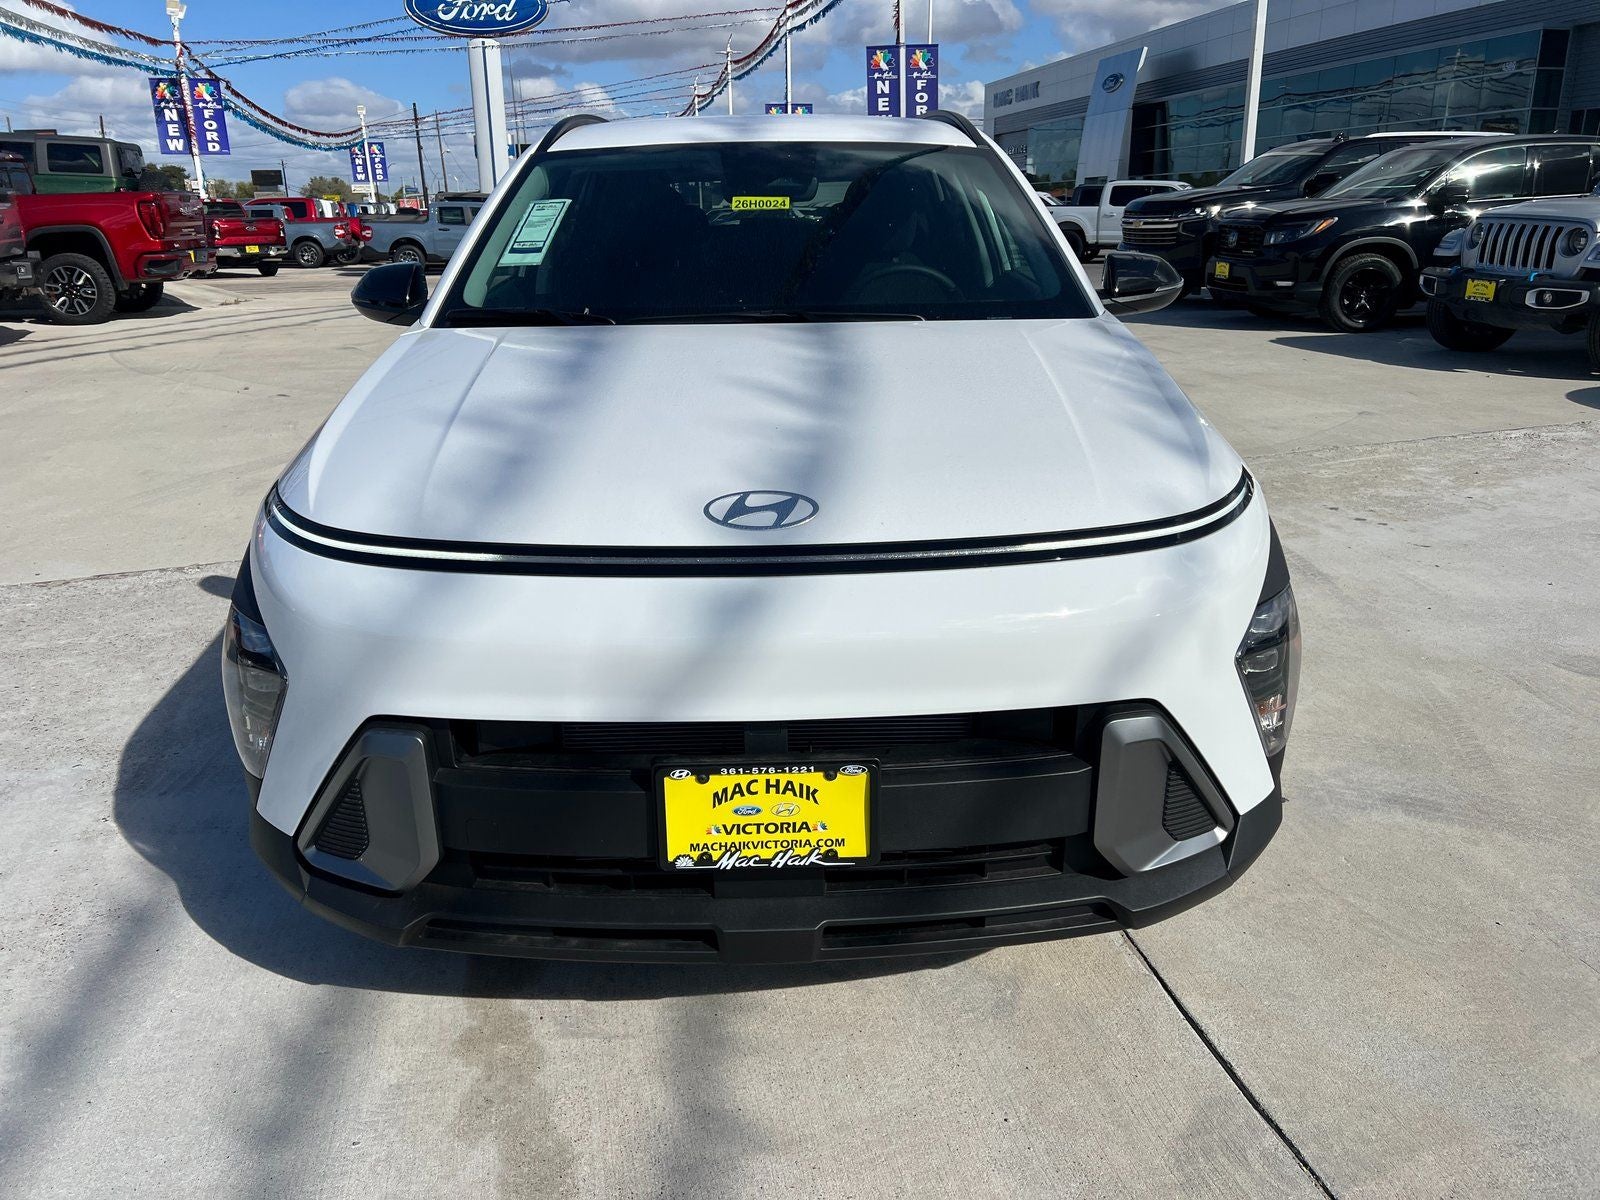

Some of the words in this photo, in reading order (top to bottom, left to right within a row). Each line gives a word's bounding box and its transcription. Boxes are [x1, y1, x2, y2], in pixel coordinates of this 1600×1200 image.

[437, 0, 518, 21] Ford
[876, 80, 893, 117] NE
[914, 79, 929, 116] FOR
[163, 108, 184, 151] NEW
[203, 109, 220, 152] FORD
[355, 157, 366, 181] NEW
[374, 157, 384, 181] FORD
[734, 199, 787, 209] 26H0024
[720, 765, 816, 775] 361-576-1221
[711, 778, 759, 809] MAC
[764, 778, 820, 806] HAIK
[736, 807, 758, 816] Ford
[721, 821, 813, 836] VICTORIA
[689, 838, 846, 853] MACHAIKVICTORIA.COM
[714, 850, 762, 870] Mac
[770, 847, 826, 870] Haik
